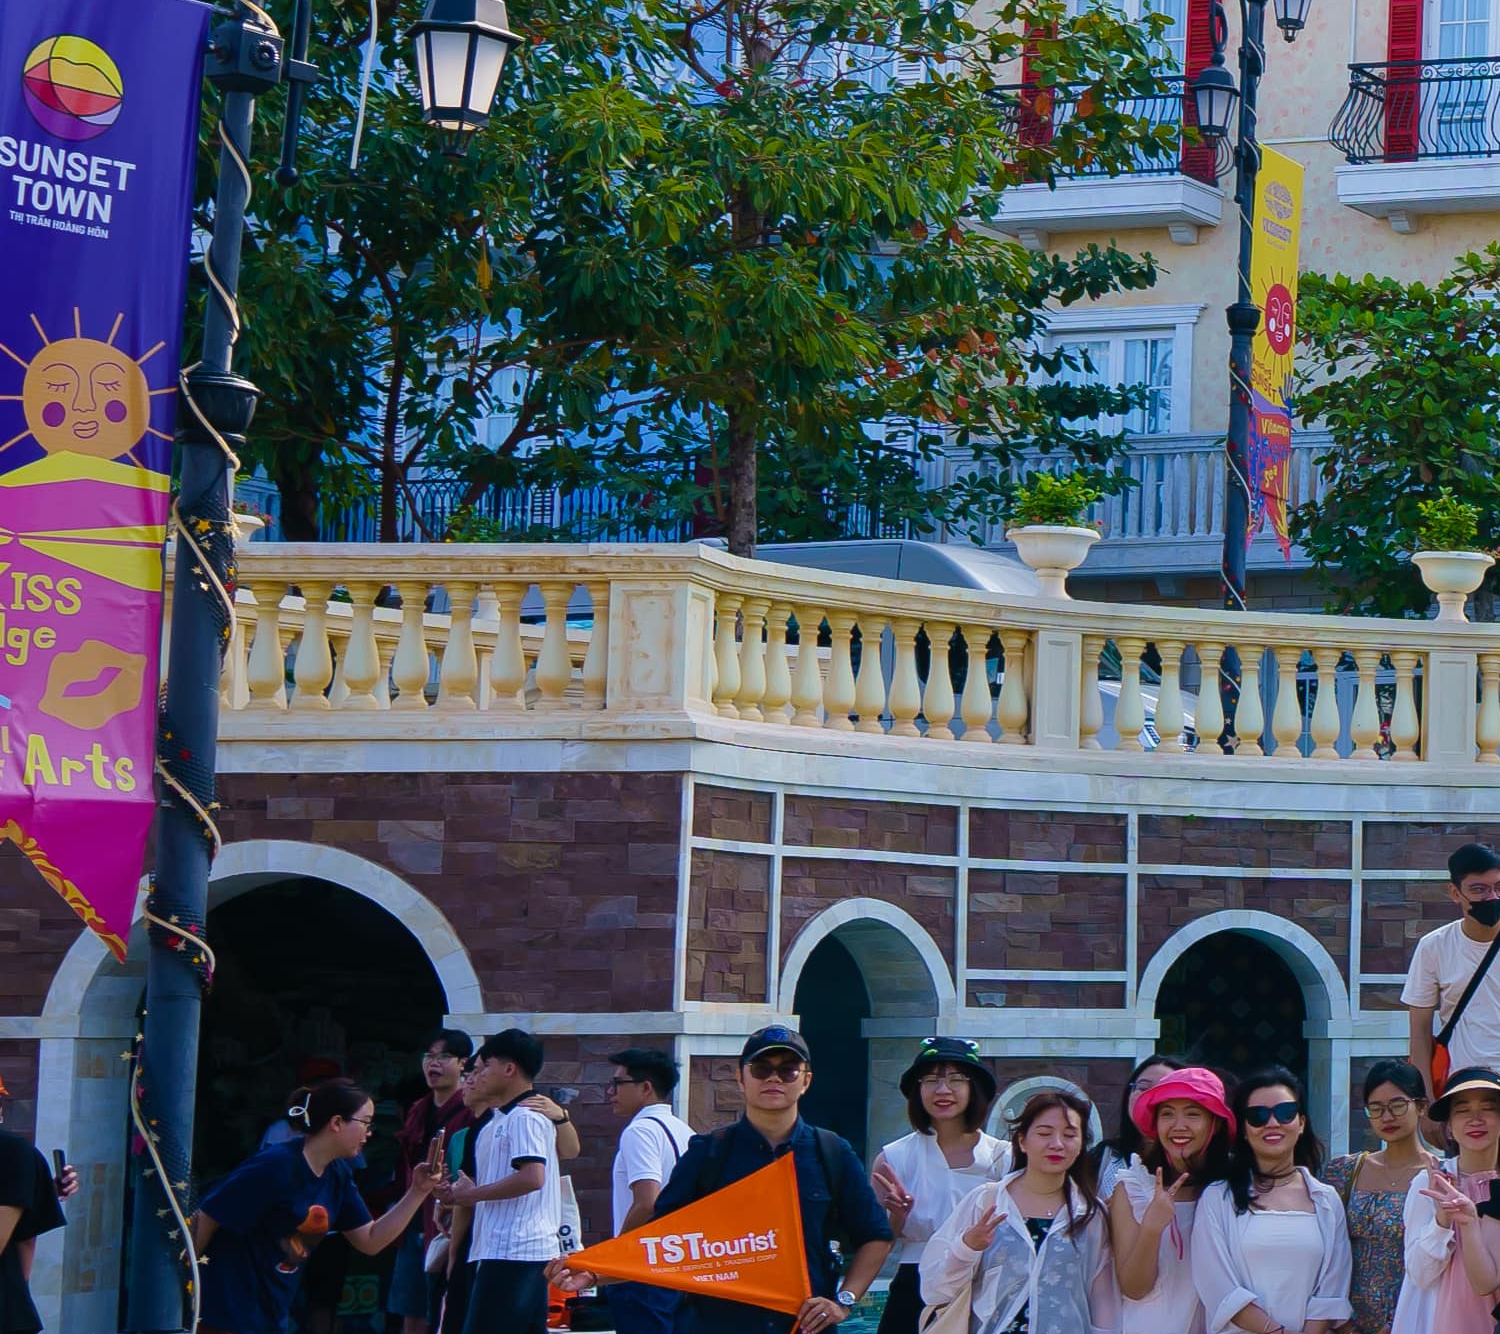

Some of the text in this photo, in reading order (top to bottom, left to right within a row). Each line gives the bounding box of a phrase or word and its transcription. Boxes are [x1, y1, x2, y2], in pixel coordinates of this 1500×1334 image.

[0, 135, 137, 192] SUNSET
[12, 174, 113, 224] TOWN
[24, 733, 137, 792] Arts
[715, 1271, 739, 1281] NAM
